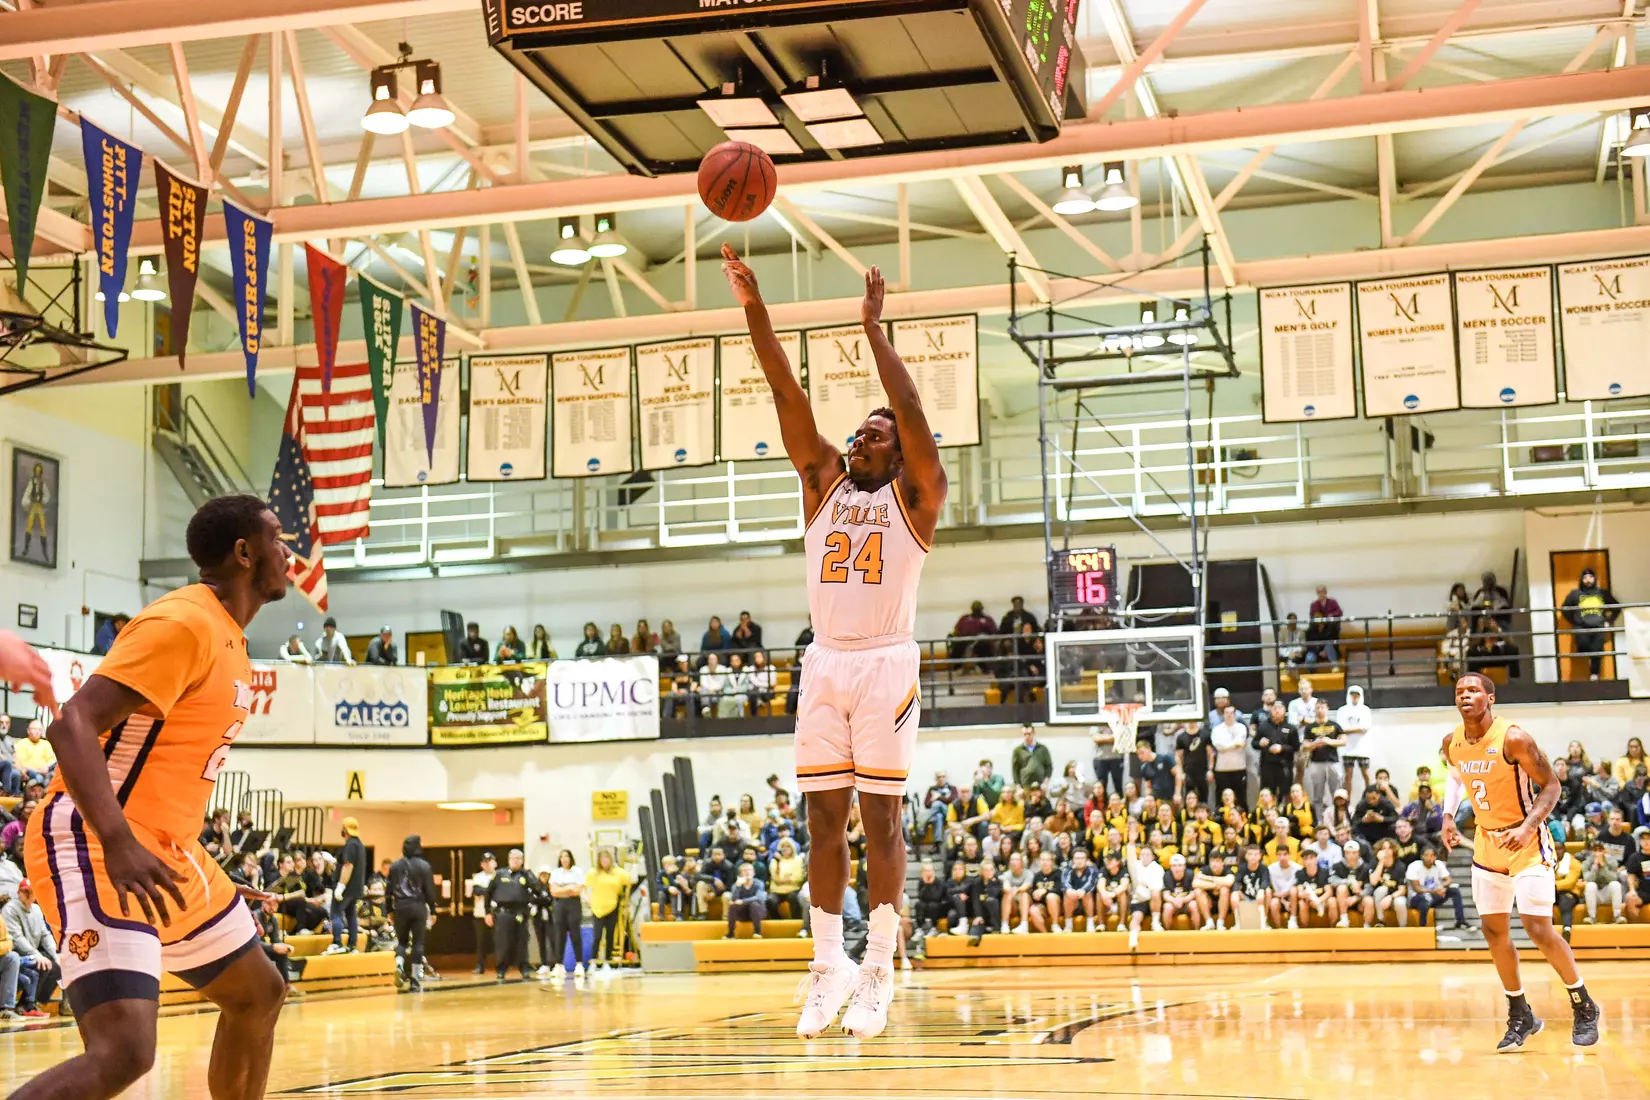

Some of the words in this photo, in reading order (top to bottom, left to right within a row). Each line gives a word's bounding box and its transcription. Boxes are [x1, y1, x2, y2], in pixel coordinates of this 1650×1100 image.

[511, 2, 584, 25] SCORE
[114, 143, 128, 212] PITT-
[101, 138, 115, 277] JOHNSTOWN
[168, 176, 183, 240] HILL
[182, 185, 196, 274] SETON
[1563, 266, 1587, 275] NCAA
[1590, 260, 1649, 272] TOURNAMENT
[1458, 275, 1484, 283] NCAA
[1484, 270, 1548, 282] TOURNAMENT
[243, 218, 259, 355] SHEPHERD
[1264, 291, 1287, 299] NCAA
[1289, 286, 1345, 297] TOURNAMENT
[1359, 284, 1384, 293] NCAA
[1386, 278, 1446, 291] TOURNAMENT
[1565, 303, 1611, 315] WOMEN'S
[1274, 323, 1307, 333] MEN'S
[1310, 320, 1338, 331] GOLF
[1463, 318, 1497, 329] MEN'S
[1500, 315, 1546, 326] SOCCER
[1366, 327, 1403, 338] WOMEN'S
[1405, 323, 1446, 335] LACROSSE
[420, 312, 432, 405] CHESTER
[929, 351, 970, 361] HOCKEY
[824, 369, 871, 380] FOOTBALL
[664, 384, 691, 394] MEN'S
[497, 397, 543, 405] BASKETBALL
[831, 500, 891, 528] VILLE
[820, 530, 884, 584] 24
[1076, 571, 1107, 604] 16
[444, 688, 487, 702] Heritage
[487, 686, 513, 699] Hotel
[552, 678, 654, 709] UPMC
[487, 696, 540, 711] Restaurant
[336, 705, 408, 726] CALECO
[477, 710, 508, 722] Support
[1458, 760, 1497, 774] WCU
[347, 771, 363, 799] A
[1471, 778, 1491, 811] 2
